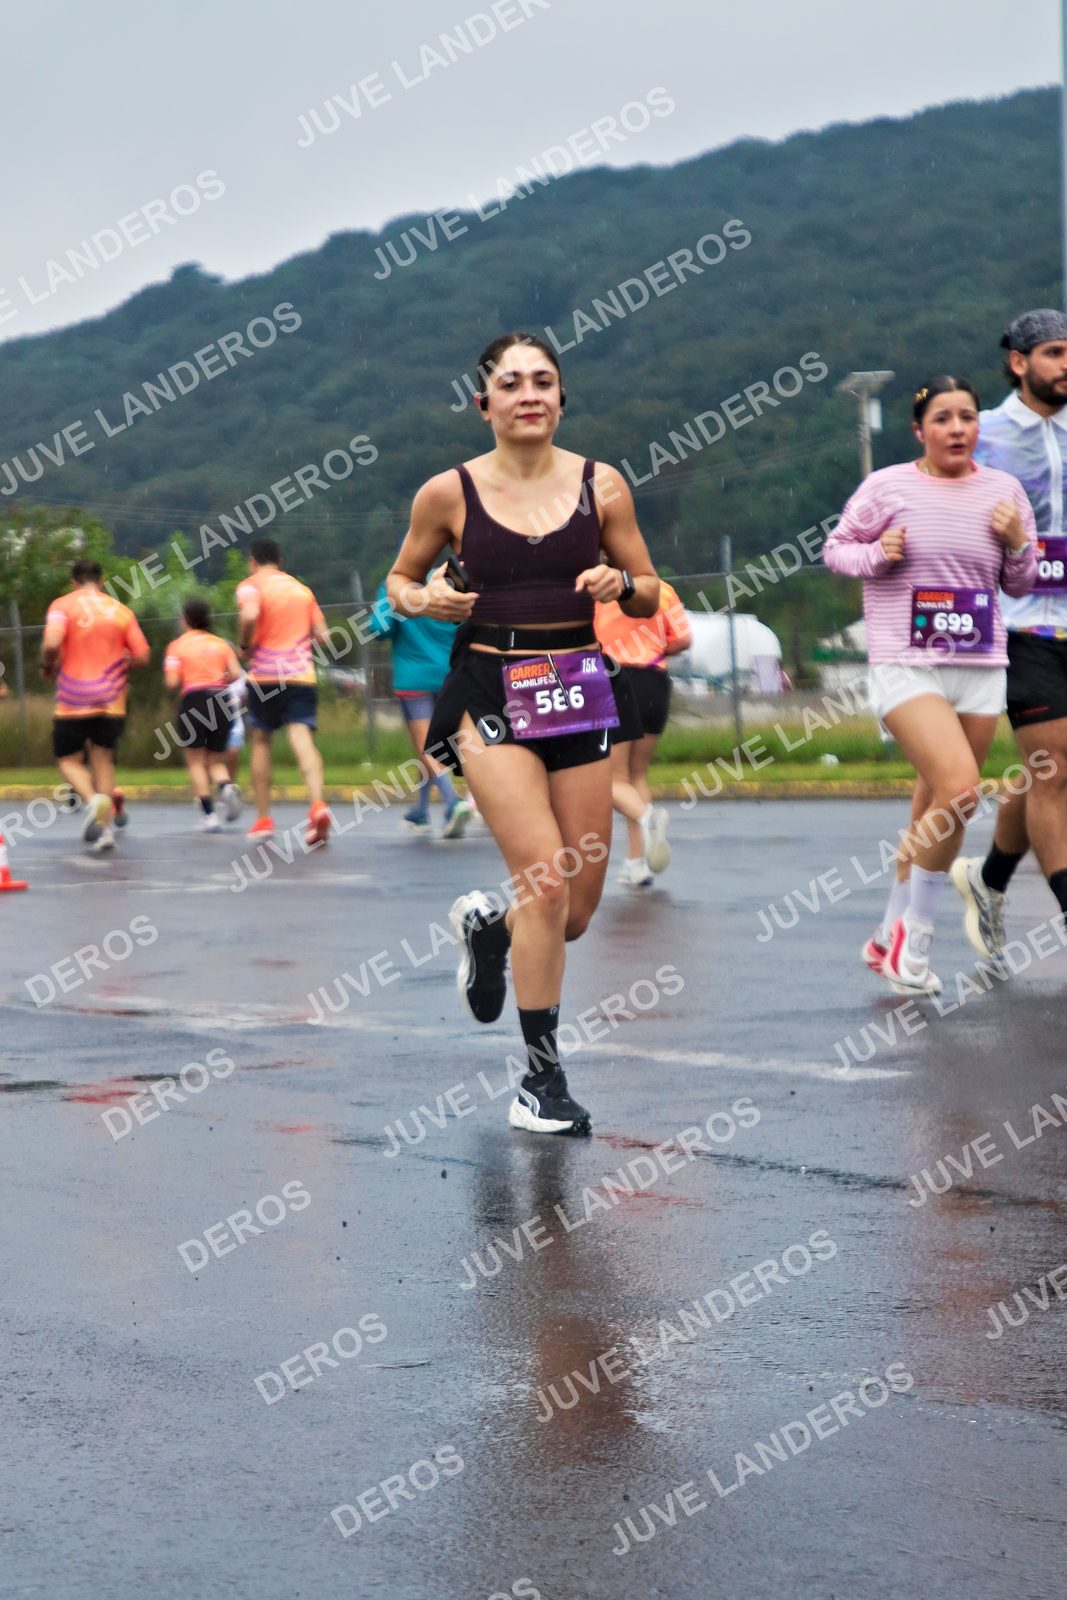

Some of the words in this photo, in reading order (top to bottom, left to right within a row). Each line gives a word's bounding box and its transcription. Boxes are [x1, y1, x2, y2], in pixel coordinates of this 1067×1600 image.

[933, 612, 974, 635] 699
[510, 661, 558, 681] CARRER
[582, 657, 598, 673] 15K
[512, 676, 548, 689] OMNILIFE
[536, 685, 584, 714] 586
